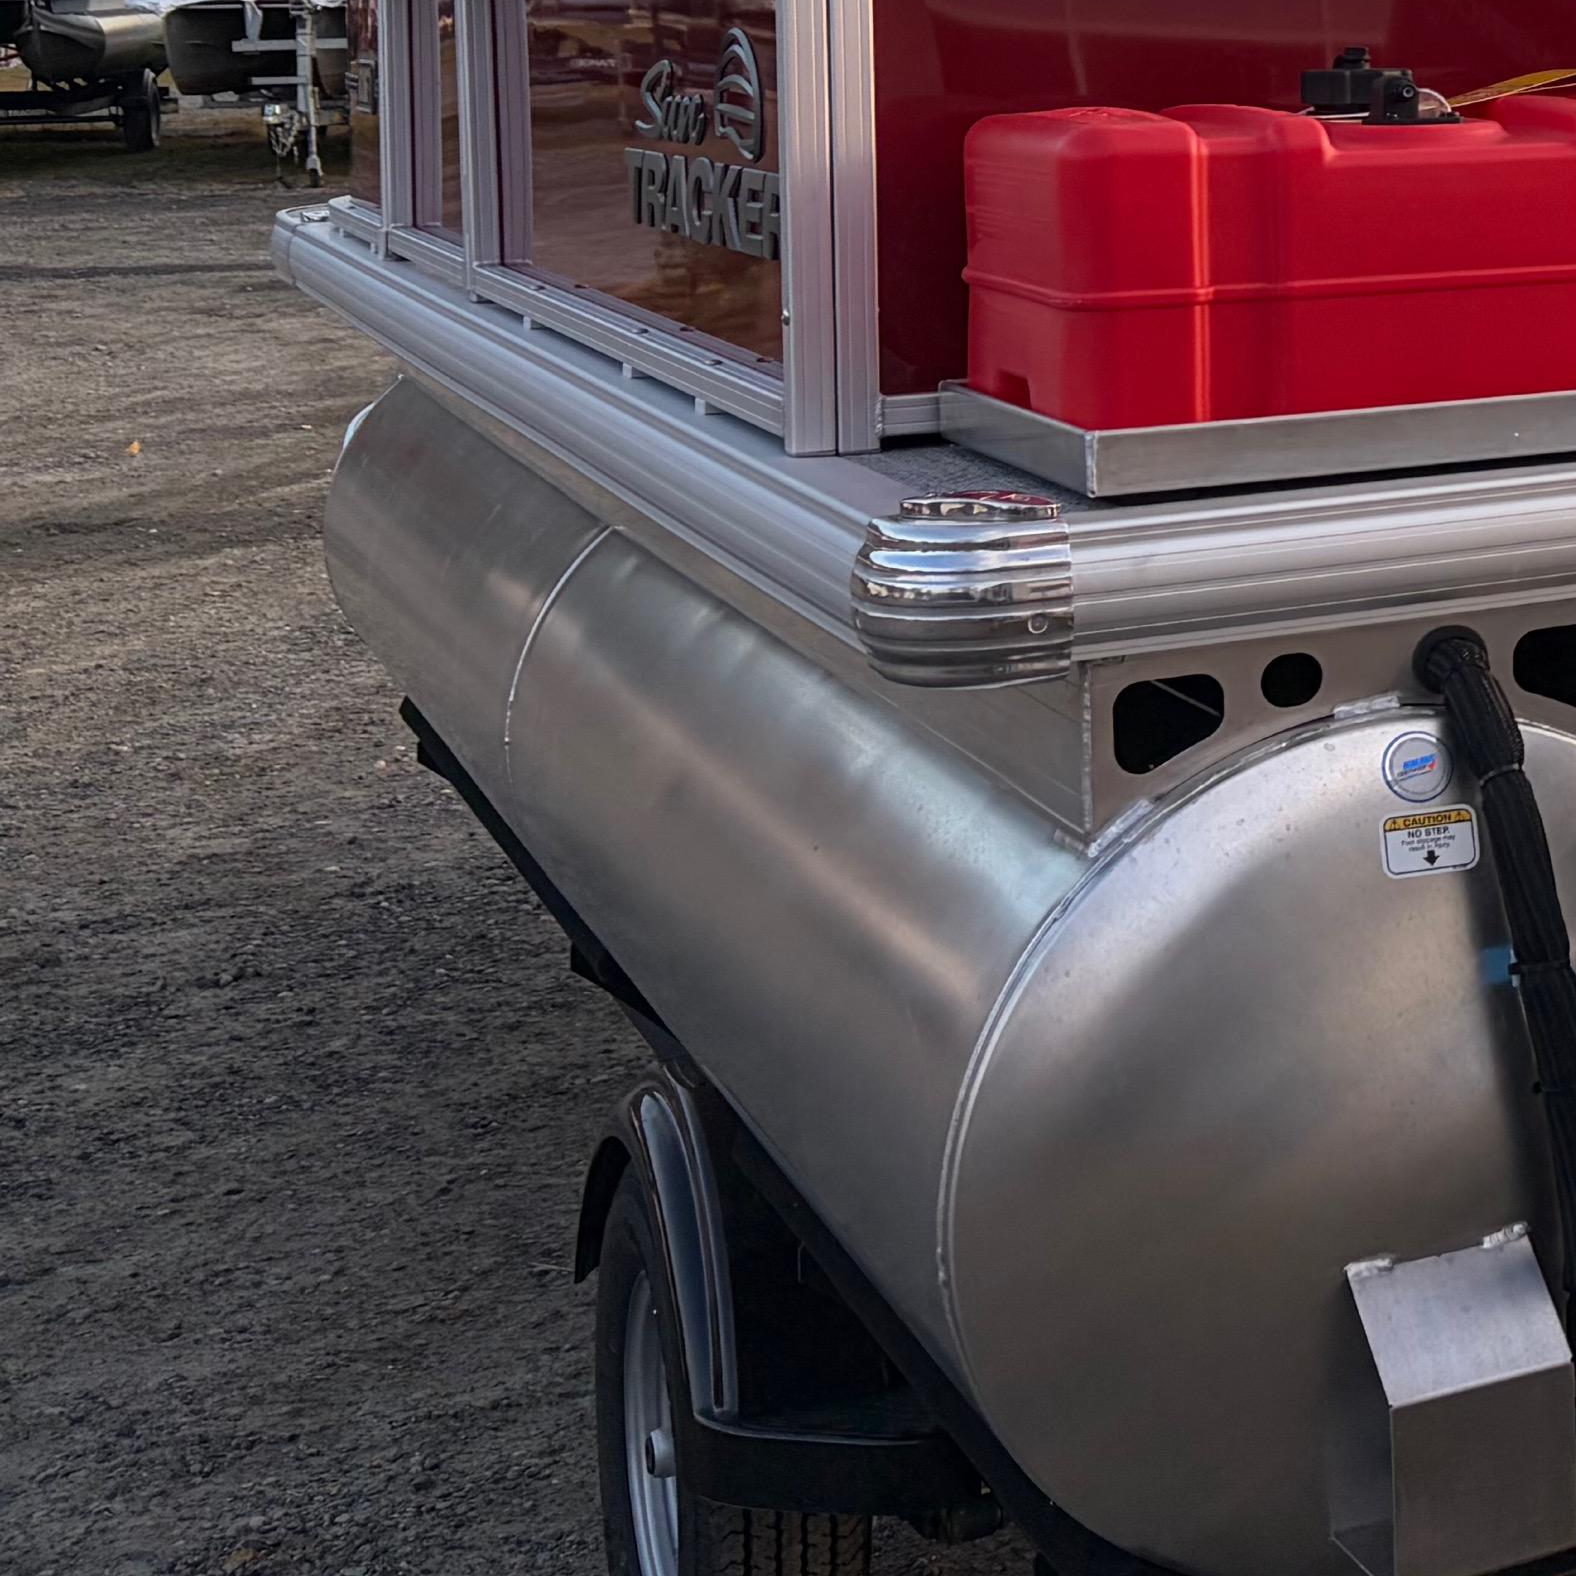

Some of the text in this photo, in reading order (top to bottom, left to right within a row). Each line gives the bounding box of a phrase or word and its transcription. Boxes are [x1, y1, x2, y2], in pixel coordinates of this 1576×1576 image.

[635, 59, 708, 145] Sun
[624, 147, 781, 261] TRACKER
[1403, 813, 1451, 827] CAUTION
[1407, 829, 1422, 838] NO
